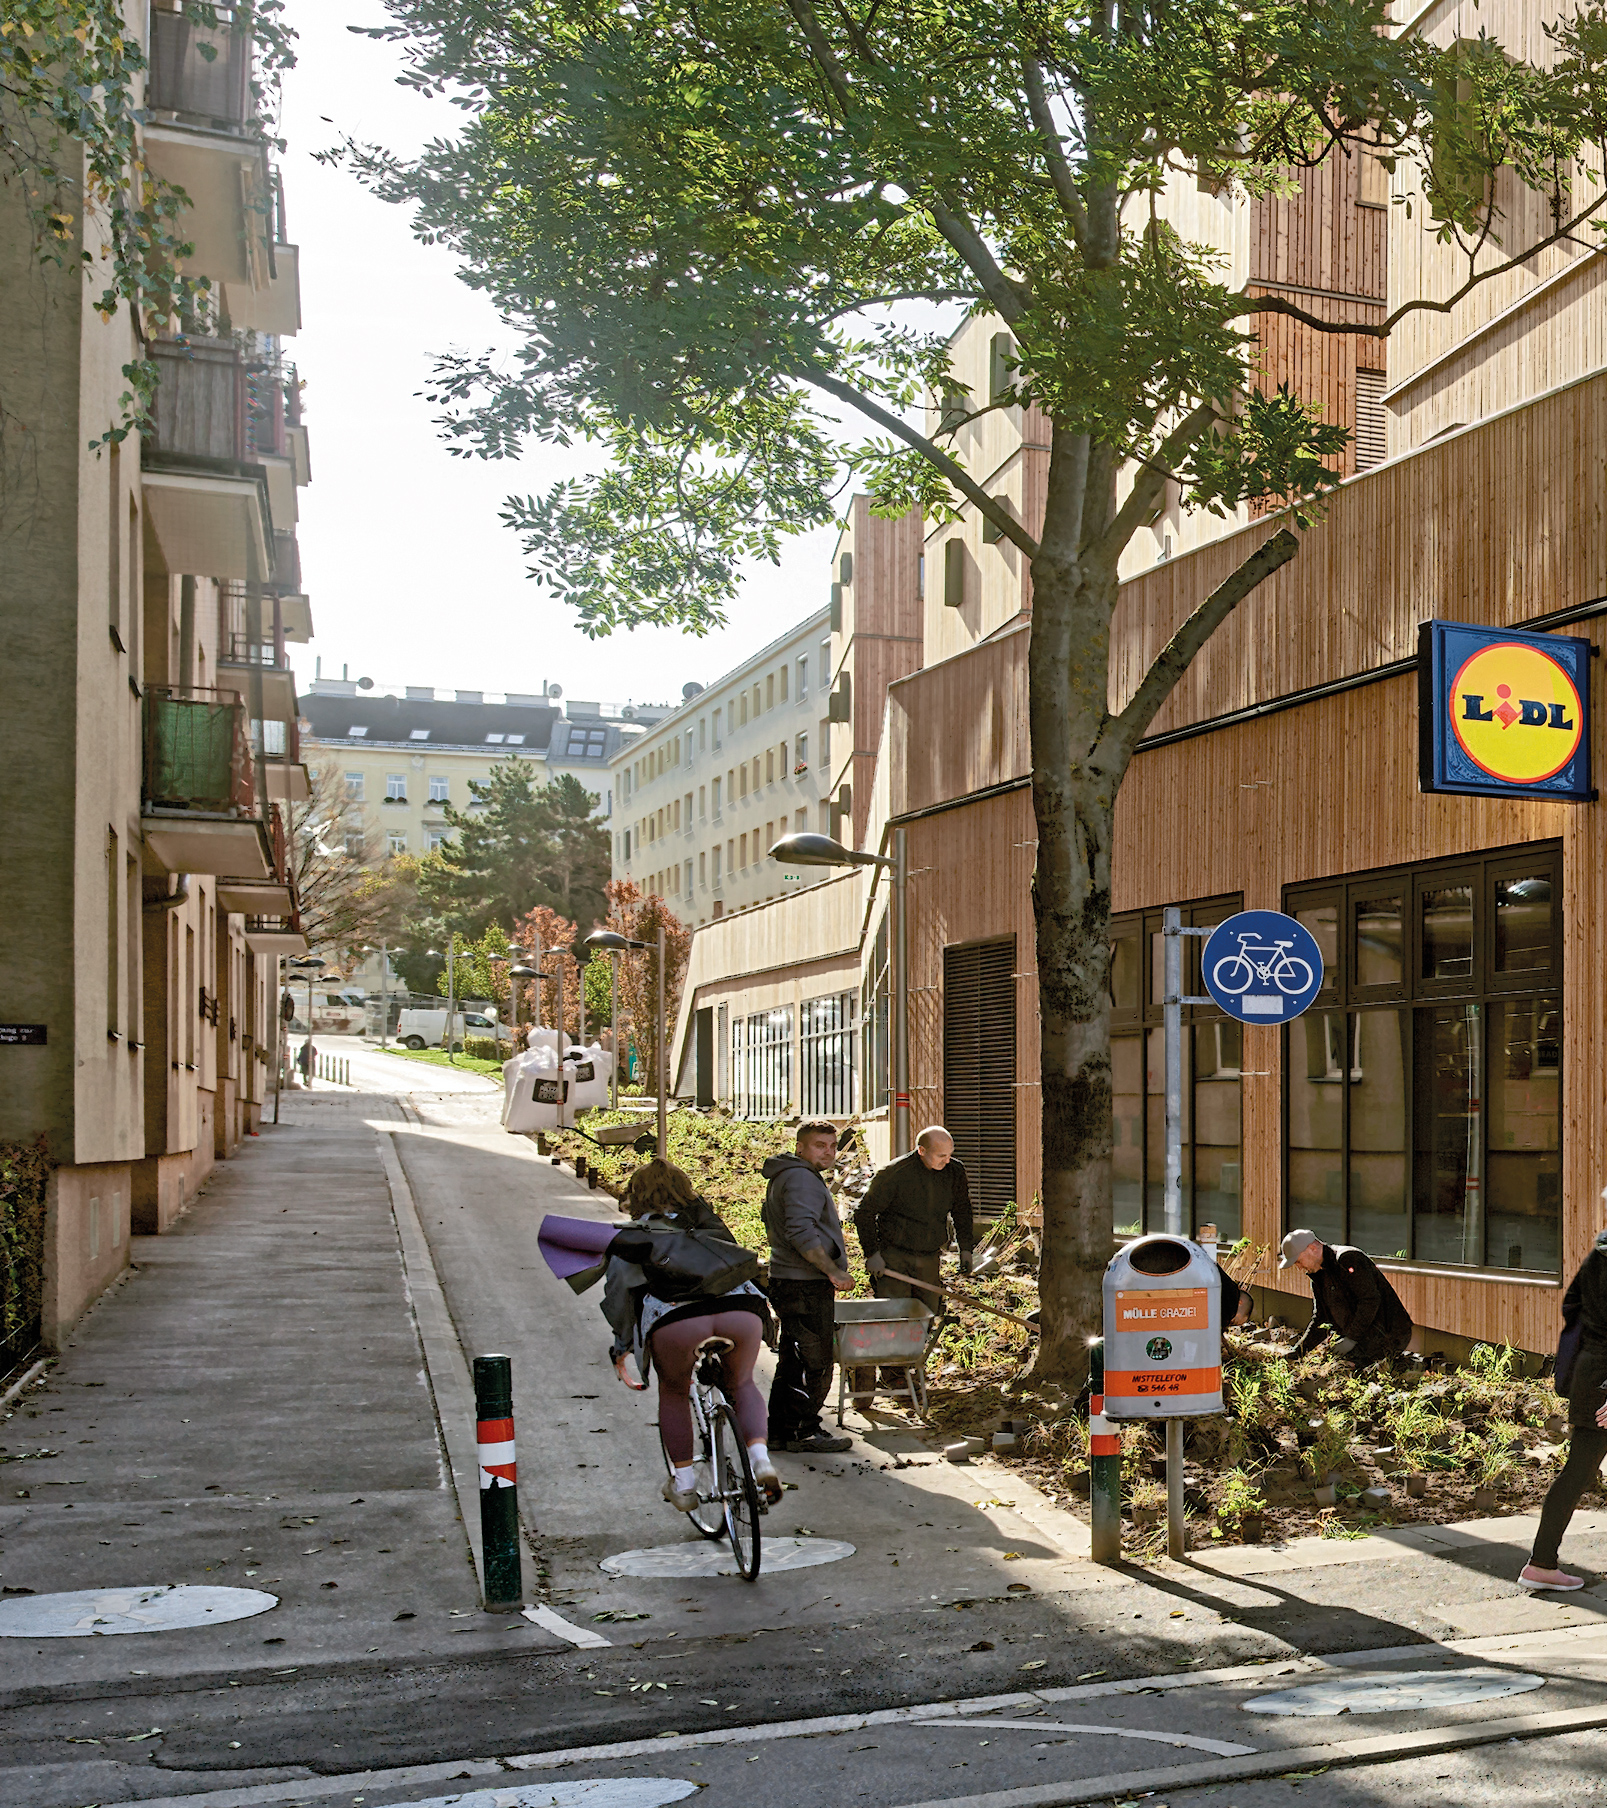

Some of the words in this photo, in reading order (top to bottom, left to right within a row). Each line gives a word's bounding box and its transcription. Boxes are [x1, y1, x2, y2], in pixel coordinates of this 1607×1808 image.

[1462, 683, 1573, 730] LIDL
[1123, 1307, 1157, 1319] MÜLLE
[1160, 1306, 1197, 1318] GRAZIE!
[1131, 1373, 1187, 1383] MISTTELEFON
[1151, 1384, 1166, 1392] 546
[1168, 1383, 1180, 1391] 48
